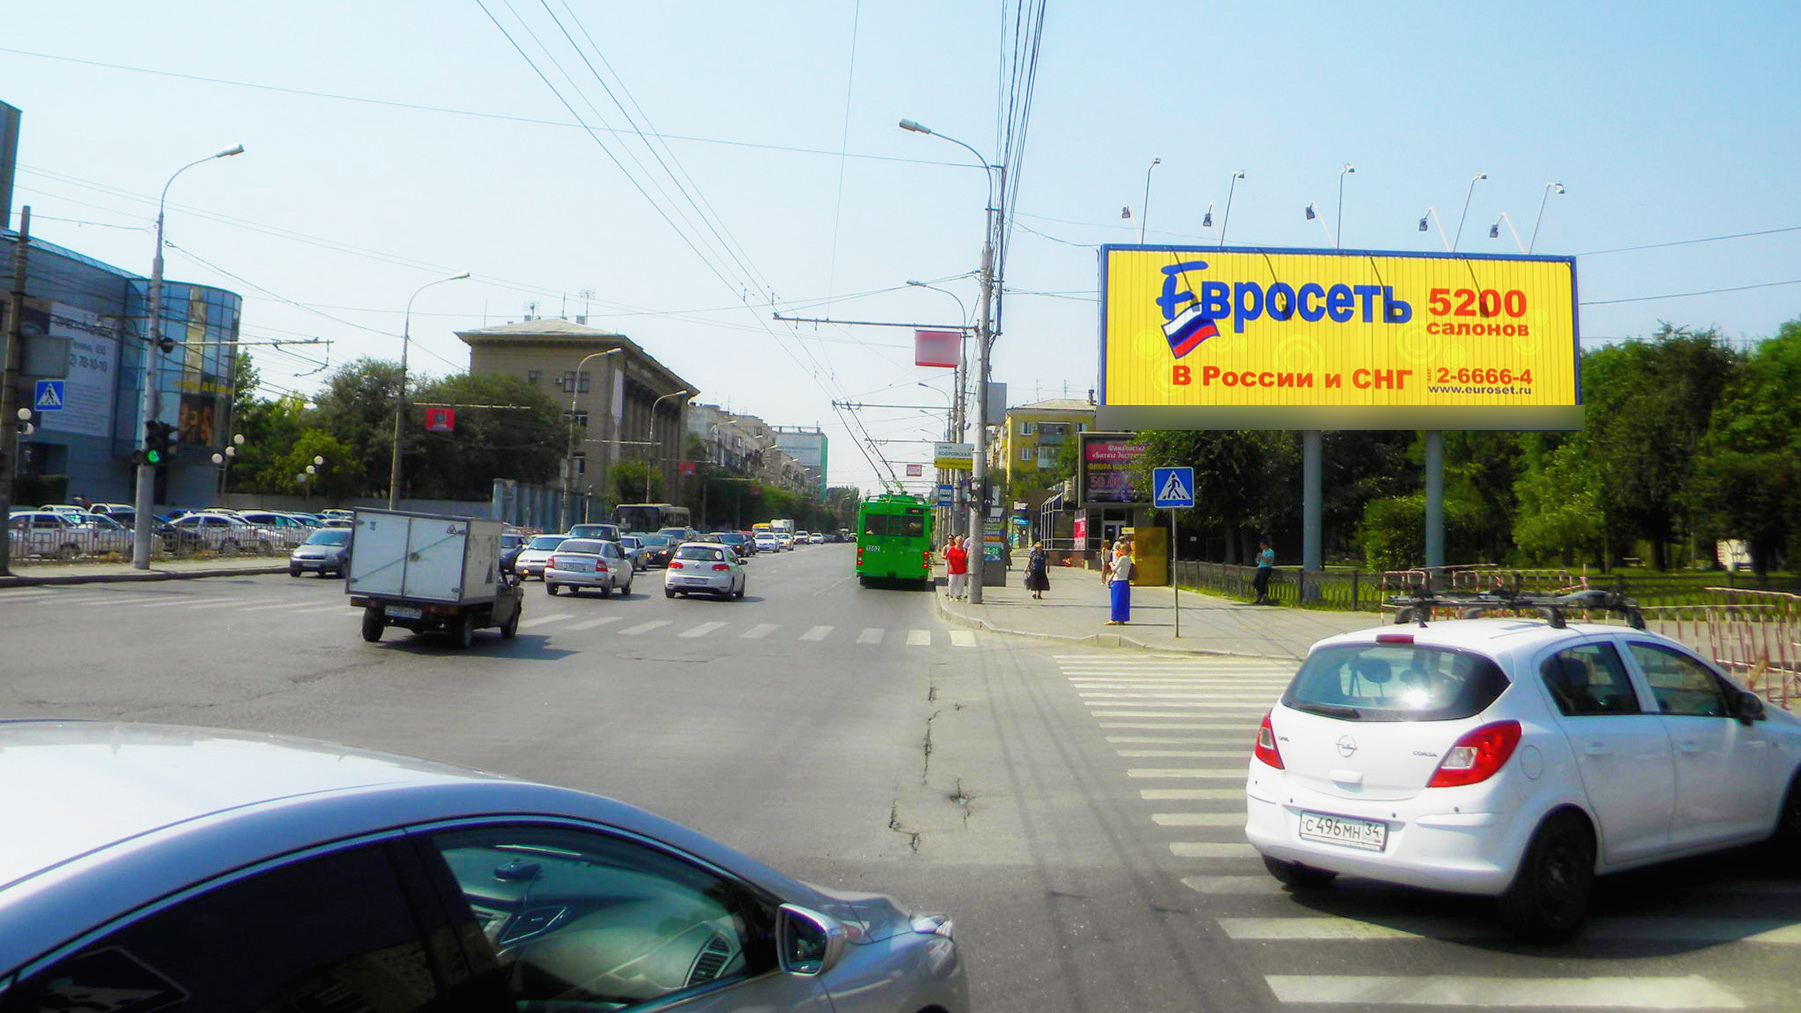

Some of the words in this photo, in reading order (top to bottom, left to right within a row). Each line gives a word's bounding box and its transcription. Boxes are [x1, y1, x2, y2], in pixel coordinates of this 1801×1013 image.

[1156, 260, 1413, 333] Евросеть
[1428, 287, 1528, 318] 5200
[1426, 321, 1530, 338] салонов
[1172, 365, 1192, 386] В
[1203, 365, 1314, 388] России
[1325, 371, 1341, 388] и
[1353, 367, 1413, 390] СНГ
[1436, 366, 1533, 386] 2-6666-4
[1428, 384, 1532, 396] www.euroset.ru
